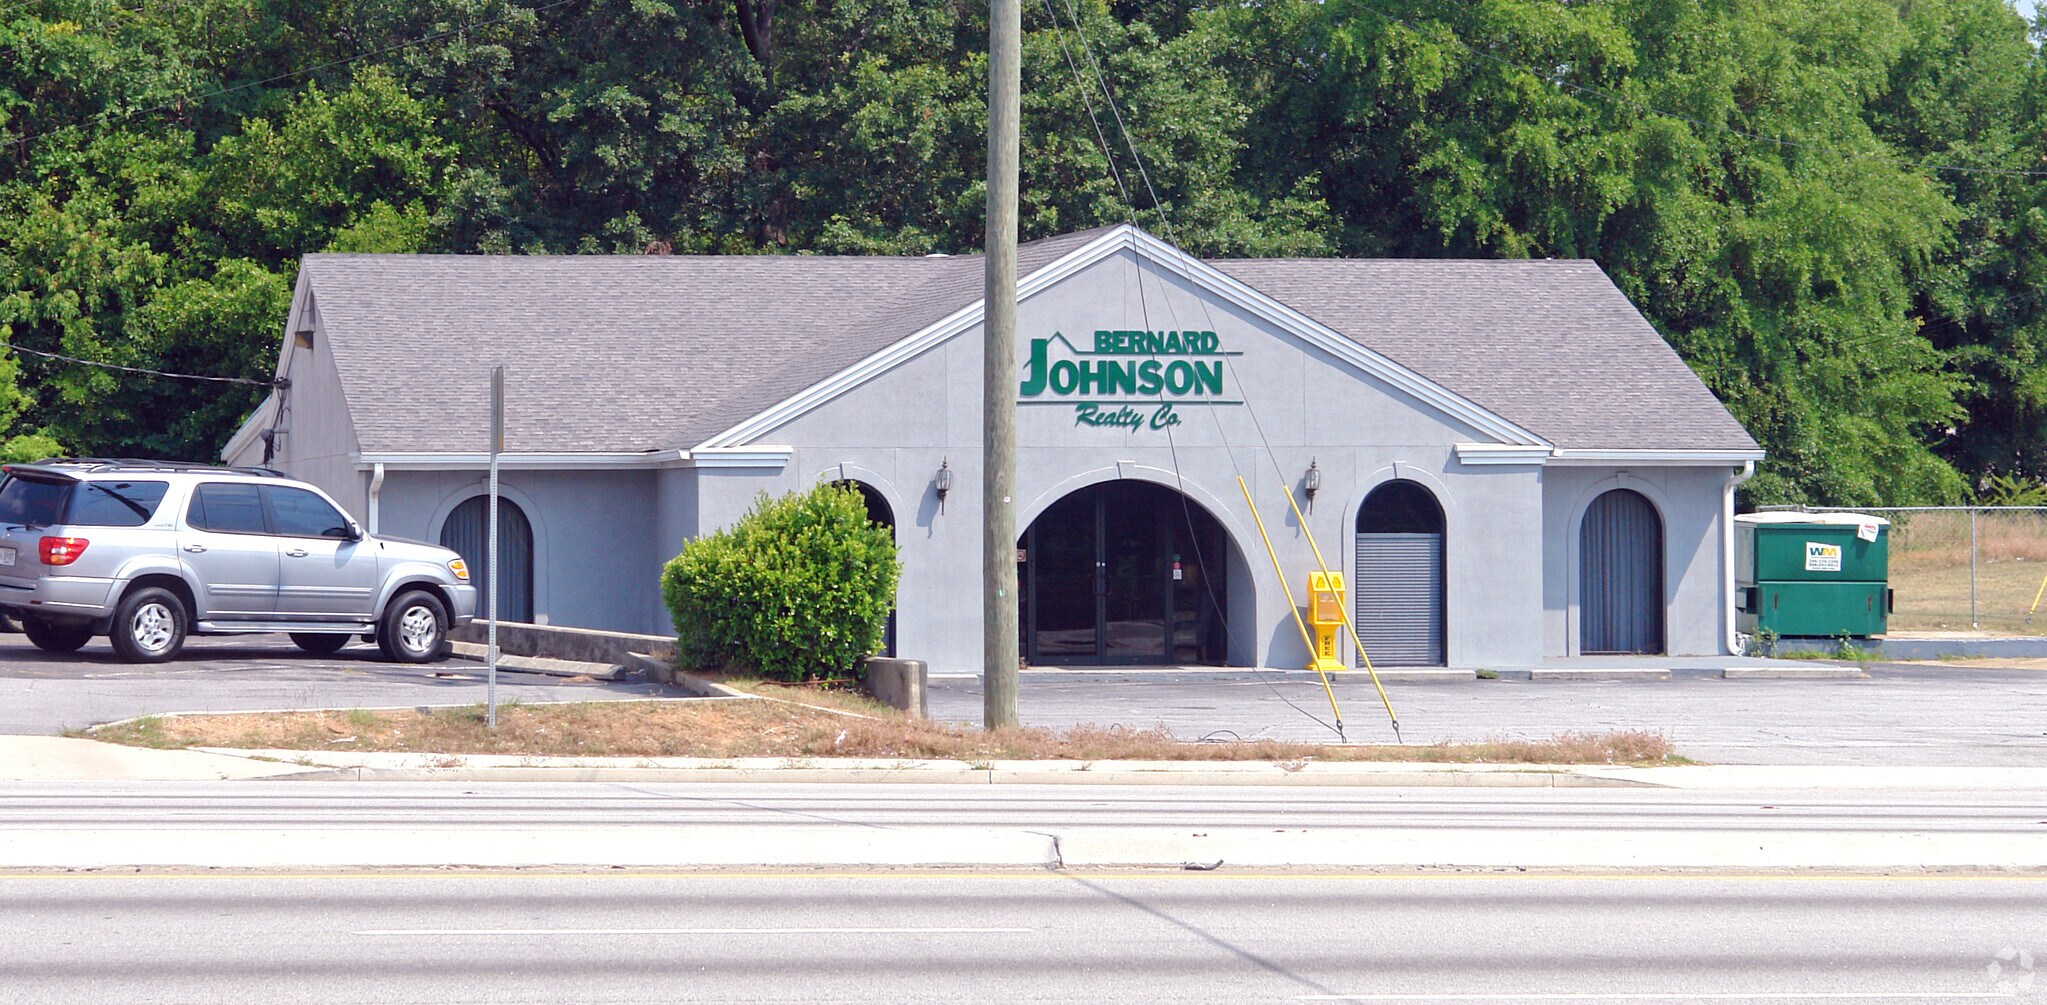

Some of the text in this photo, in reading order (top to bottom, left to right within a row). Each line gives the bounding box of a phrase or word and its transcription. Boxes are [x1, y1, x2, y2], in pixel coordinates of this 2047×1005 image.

[1094, 330, 1220, 353] BERNARD
[1019, 338, 1223, 396] JOHNSON
[1074, 402, 1145, 434] Realty
[1809, 547, 1837, 556] WM
